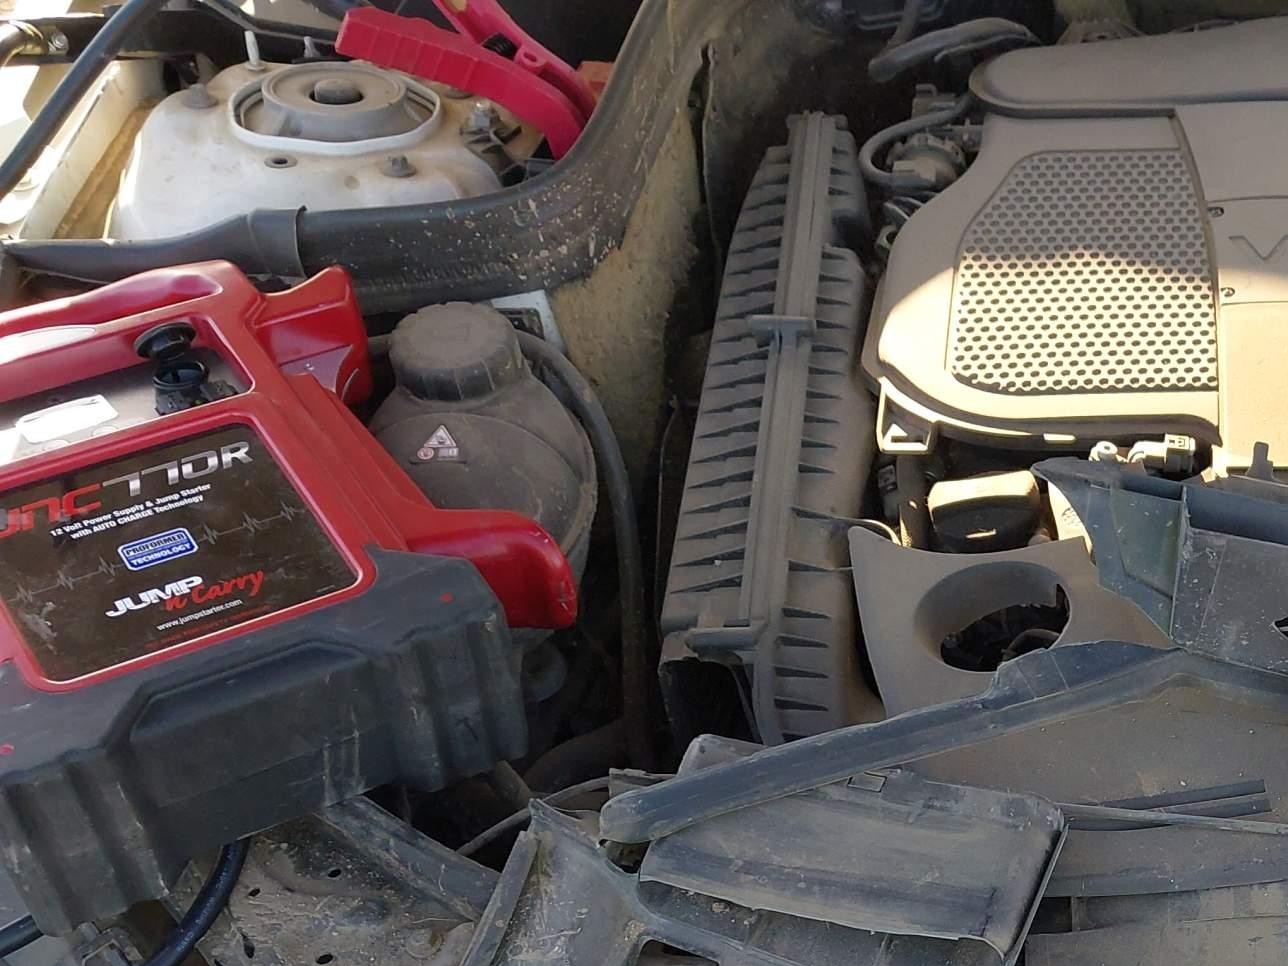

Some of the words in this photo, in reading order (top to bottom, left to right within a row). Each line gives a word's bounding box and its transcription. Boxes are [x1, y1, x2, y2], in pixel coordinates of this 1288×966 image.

[50, 528, 63, 537] 12
[62, 522, 83, 533] Volt
[83, 513, 112, 526] Power
[112, 504, 145, 518] Supply
[145, 499, 154, 508] &
[155, 493, 180, 507] Jump
[179, 483, 212, 498] Starter
[70, 528, 93, 539] with
[93, 521, 117, 533] AUTO
[118, 511, 155, 525] CHARGE
[155, 494, 205, 513] Technology
[126, 532, 186, 557] PROFORMER
[130, 543, 193, 566] TECHNOLOGY
[105, 576, 203, 618] JUMP
[163, 596, 189, 611] n
[191, 570, 265, 604] Carry
[156, 599, 244, 631] www.jumpstarter.com
